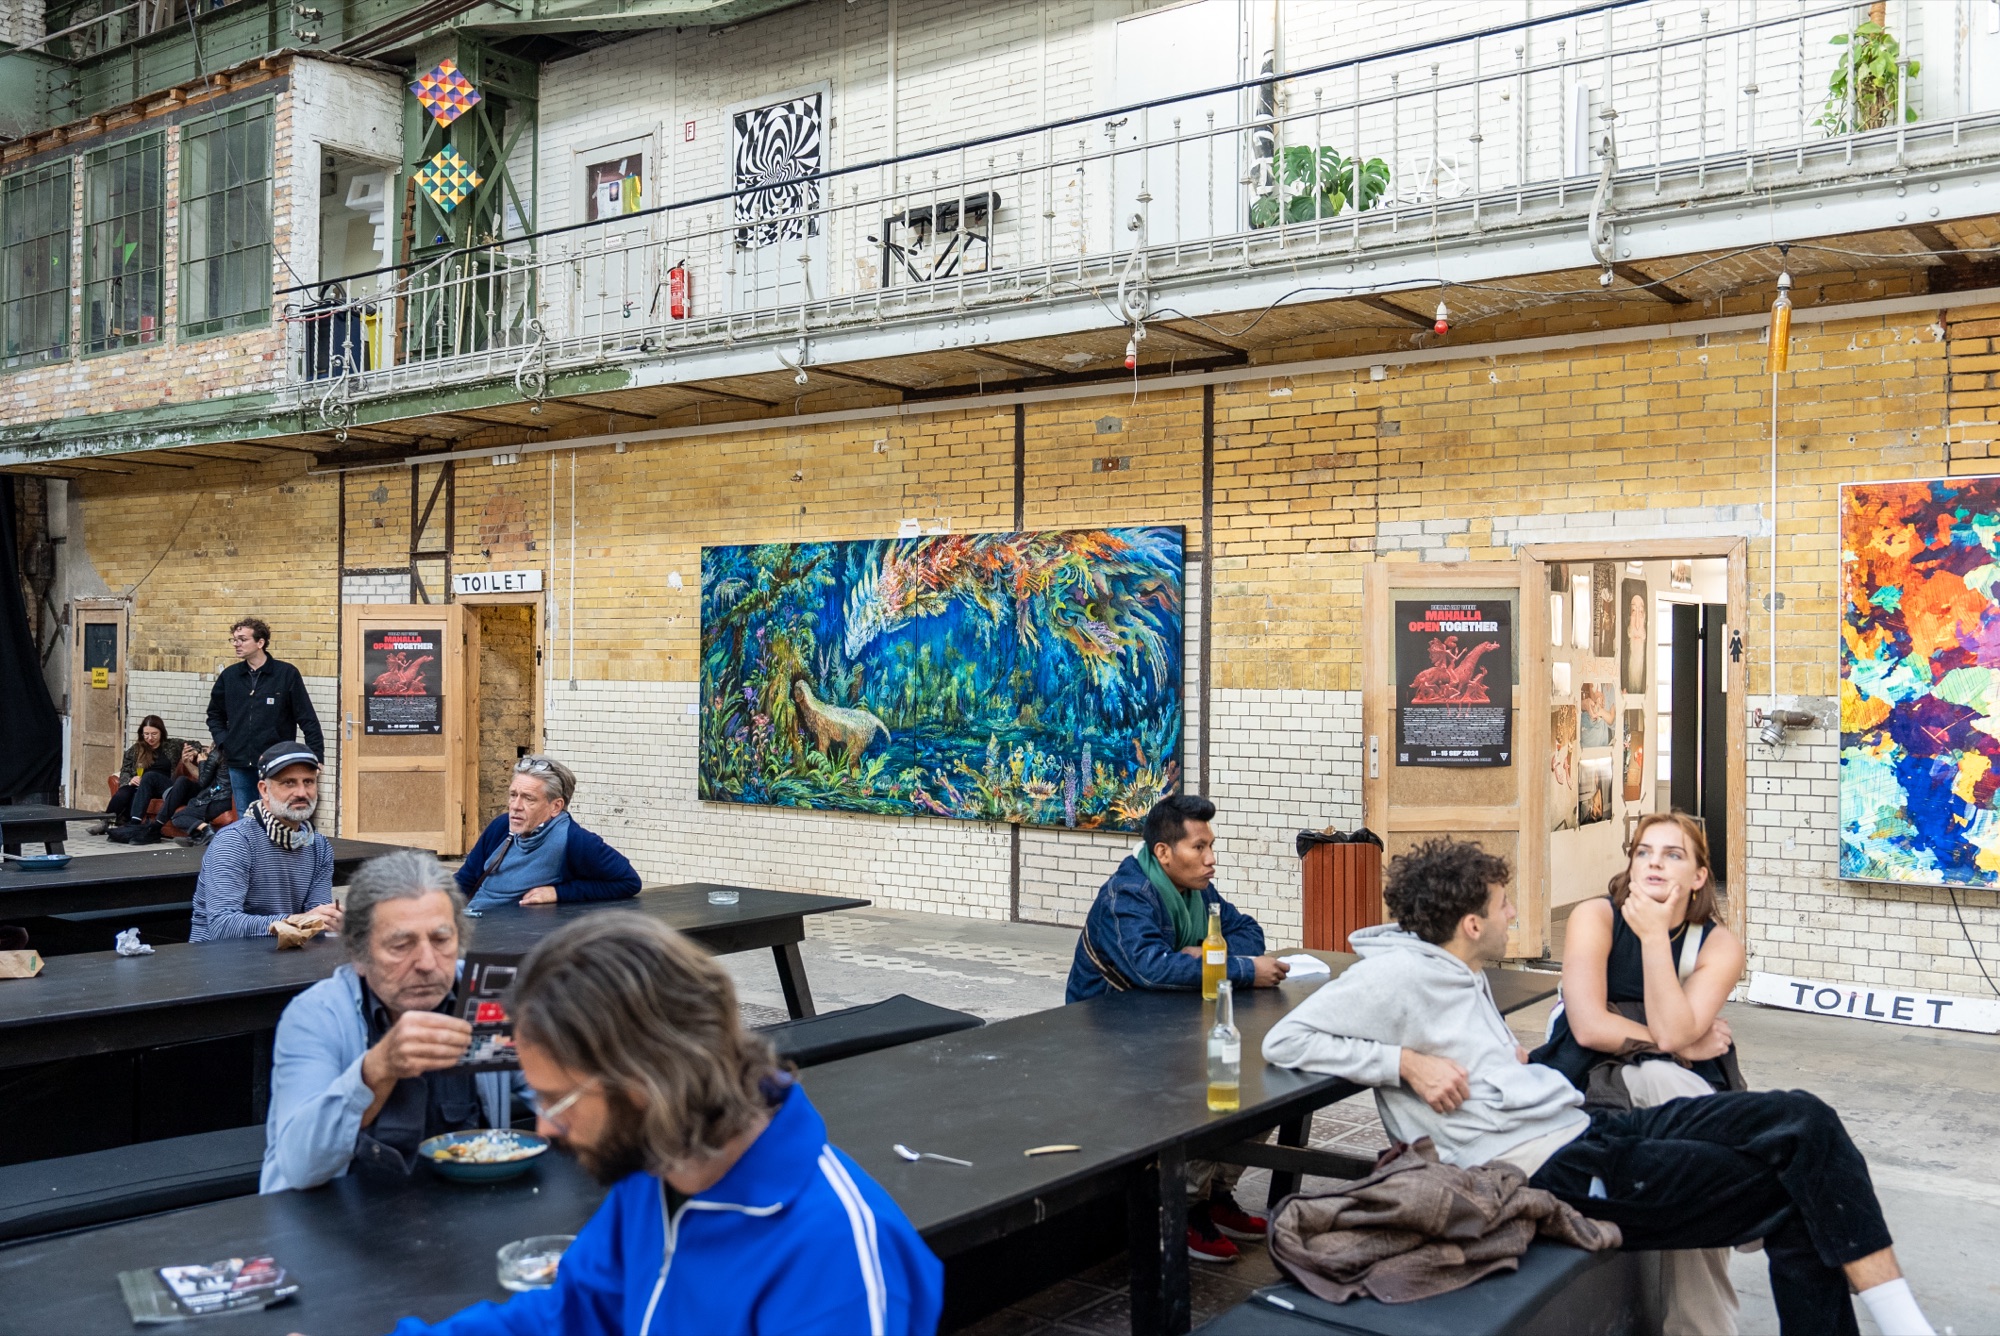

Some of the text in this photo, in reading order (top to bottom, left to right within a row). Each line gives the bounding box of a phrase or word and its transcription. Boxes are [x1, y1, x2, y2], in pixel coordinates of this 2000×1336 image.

[461, 573, 526, 592] TOILET
[1425, 610, 1482, 621] MAHALLA
[1408, 621, 1498, 632] OPENTOGETHER
[1790, 982, 1953, 1024] TOILET
